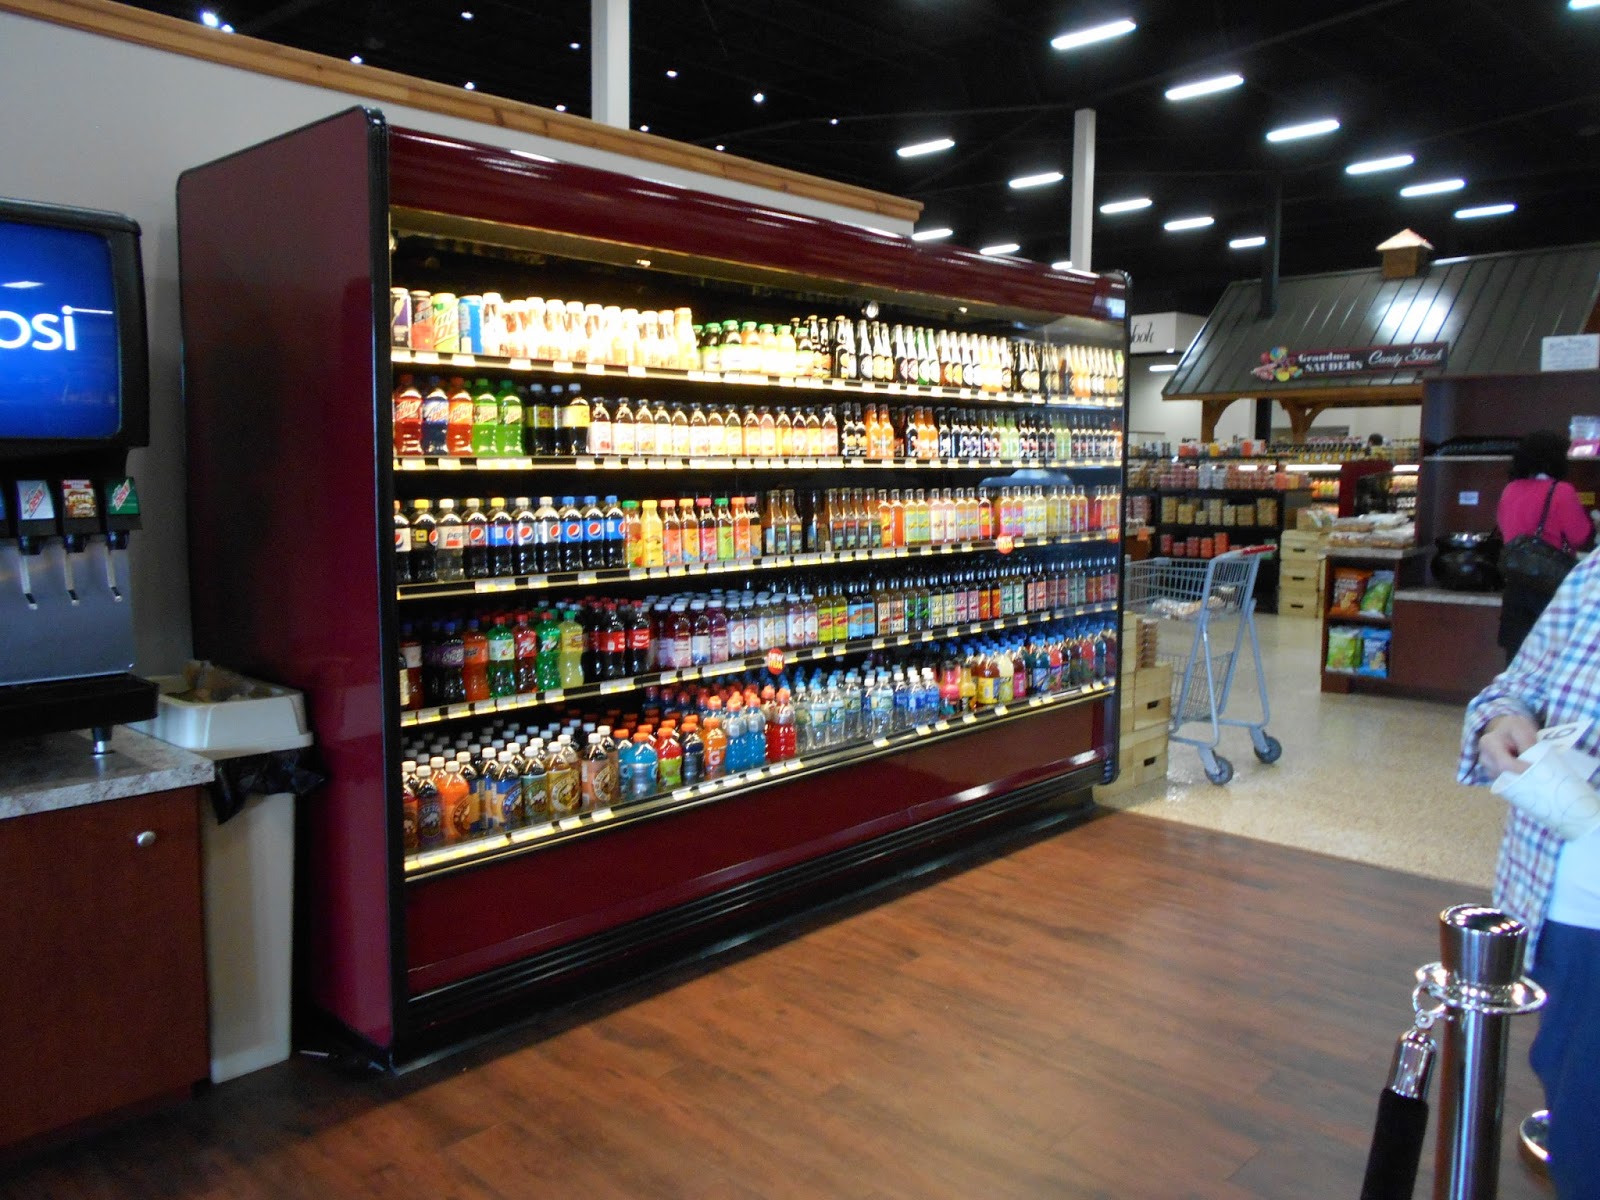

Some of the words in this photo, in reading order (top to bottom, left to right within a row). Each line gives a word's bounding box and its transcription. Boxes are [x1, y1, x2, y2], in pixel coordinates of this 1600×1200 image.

[1298, 352, 1351, 363] Grandma
[1368, 350, 1403, 368] Candy
[1405, 347, 1443, 362] Shack
[1305, 360, 1363, 373] SAUDERS
[709, 750, 721, 766] G
